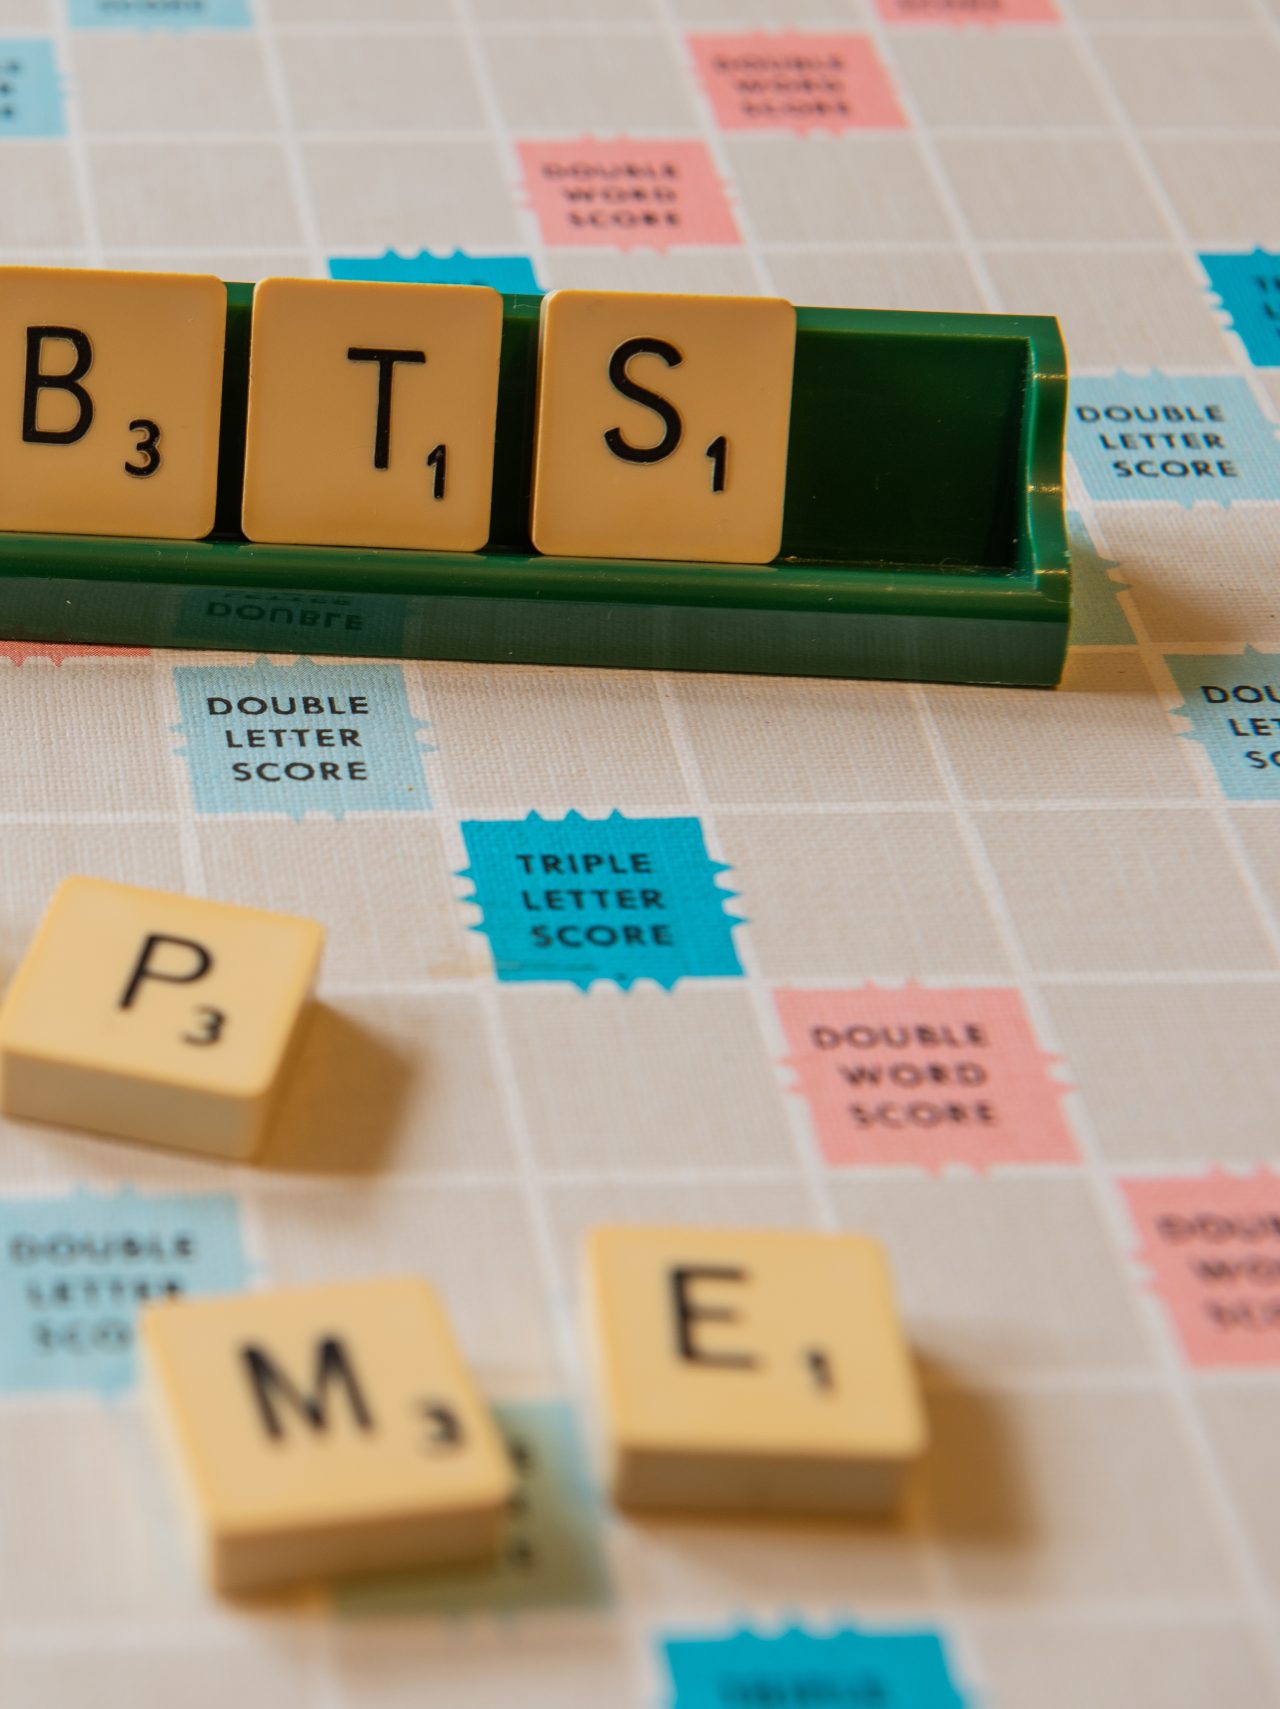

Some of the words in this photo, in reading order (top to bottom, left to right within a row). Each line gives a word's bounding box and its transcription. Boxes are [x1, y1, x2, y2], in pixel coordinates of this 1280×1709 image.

[1075, 405, 1223, 424] DOUBLE
[1098, 432, 1224, 451] LETTER
[1112, 459, 1237, 478] SCORE
[205, 695, 369, 716] DOUBLE
[224, 727, 362, 749] LETTER
[231, 760, 368, 783] SCORE
[515, 852, 653, 875] TRIPLE
[521, 887, 666, 912] LETTER
[530, 923, 673, 949] SCORE
[810, 1022, 990, 1050] DOUBLE
[840, 1062, 988, 1089] WORD
[848, 1100, 996, 1129] SCORE
